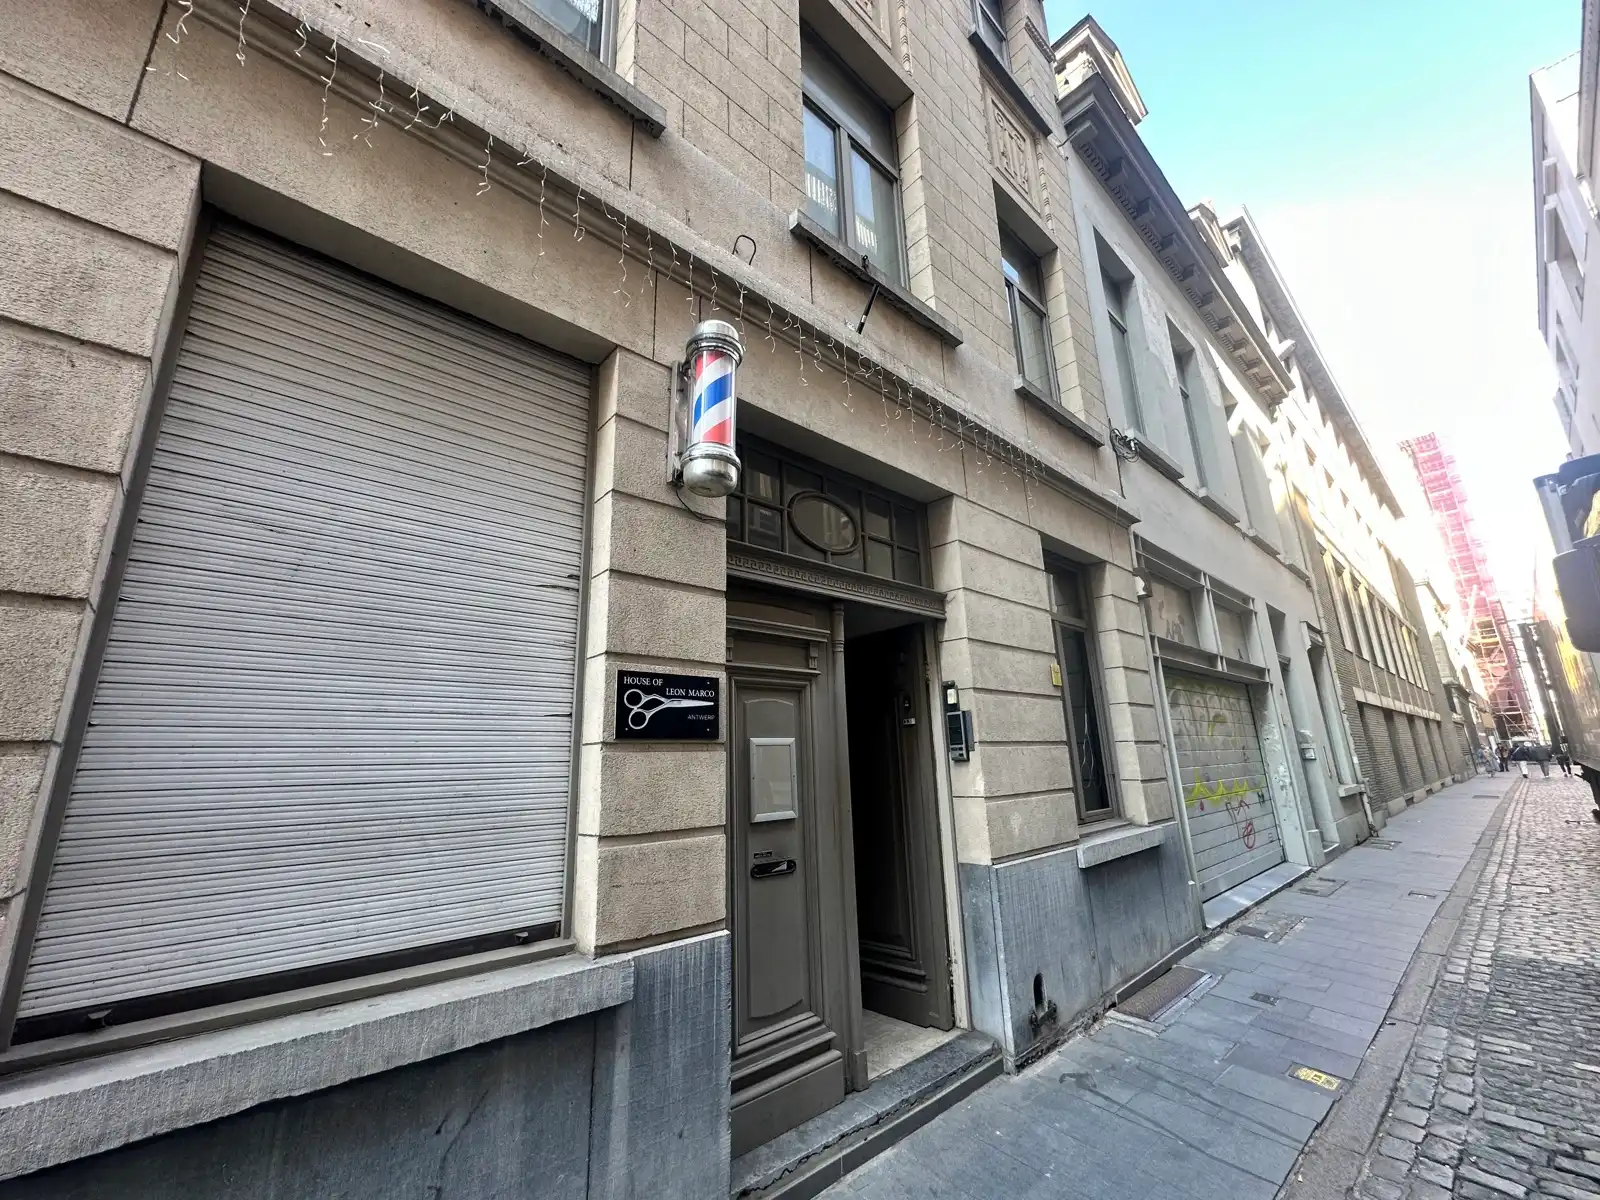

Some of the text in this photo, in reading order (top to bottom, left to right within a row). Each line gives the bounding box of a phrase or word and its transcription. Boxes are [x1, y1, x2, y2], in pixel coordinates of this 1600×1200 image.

[624, 676, 664, 686] HOUSE OF
[666, 688, 715, 698] LEON MARCO
